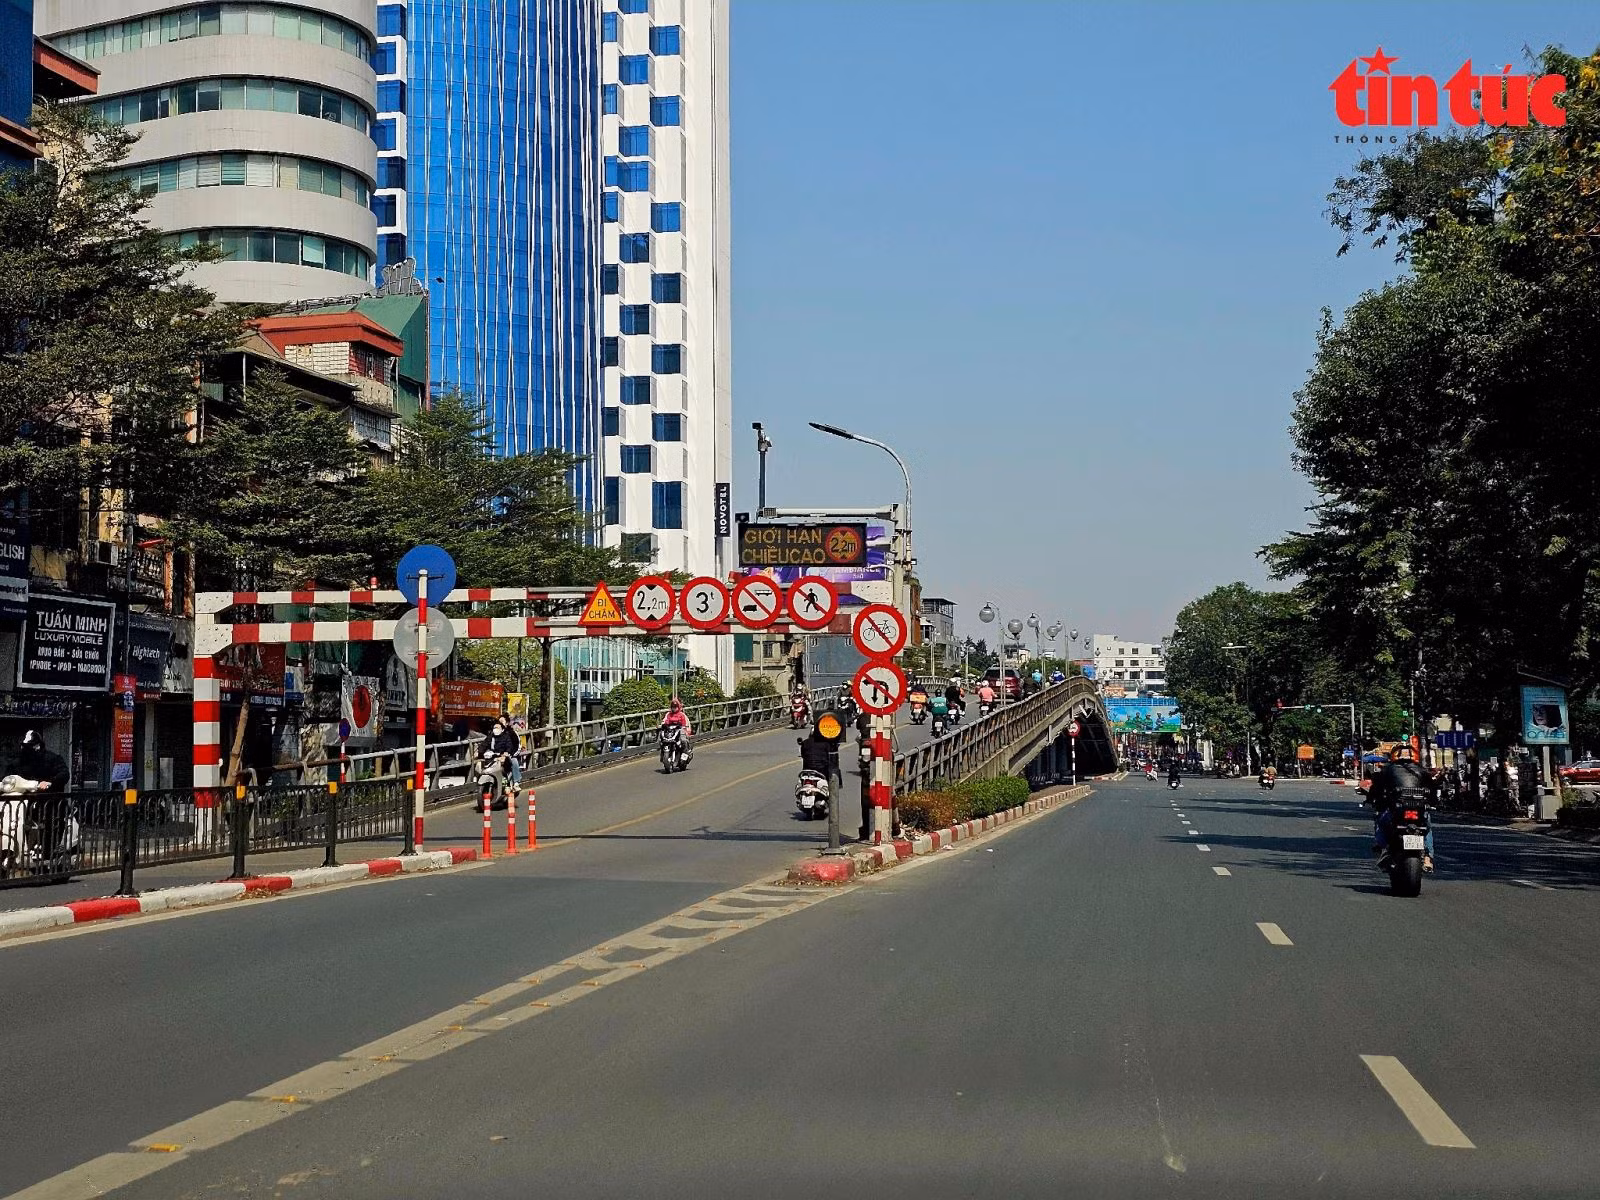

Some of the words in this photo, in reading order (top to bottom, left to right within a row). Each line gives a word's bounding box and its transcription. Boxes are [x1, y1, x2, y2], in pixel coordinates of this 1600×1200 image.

[719, 486, 728, 534] NOVOTEL
[744, 526, 781, 544] GIỚI
[787, 528, 822, 545] HẠN
[597, 598, 607, 607] ĐI
[36, 608, 72, 630] TUẤN
[75, 615, 107, 633] MINH
[34, 631, 72, 643] LUXURY
[72, 635, 104, 646] MOBILE
